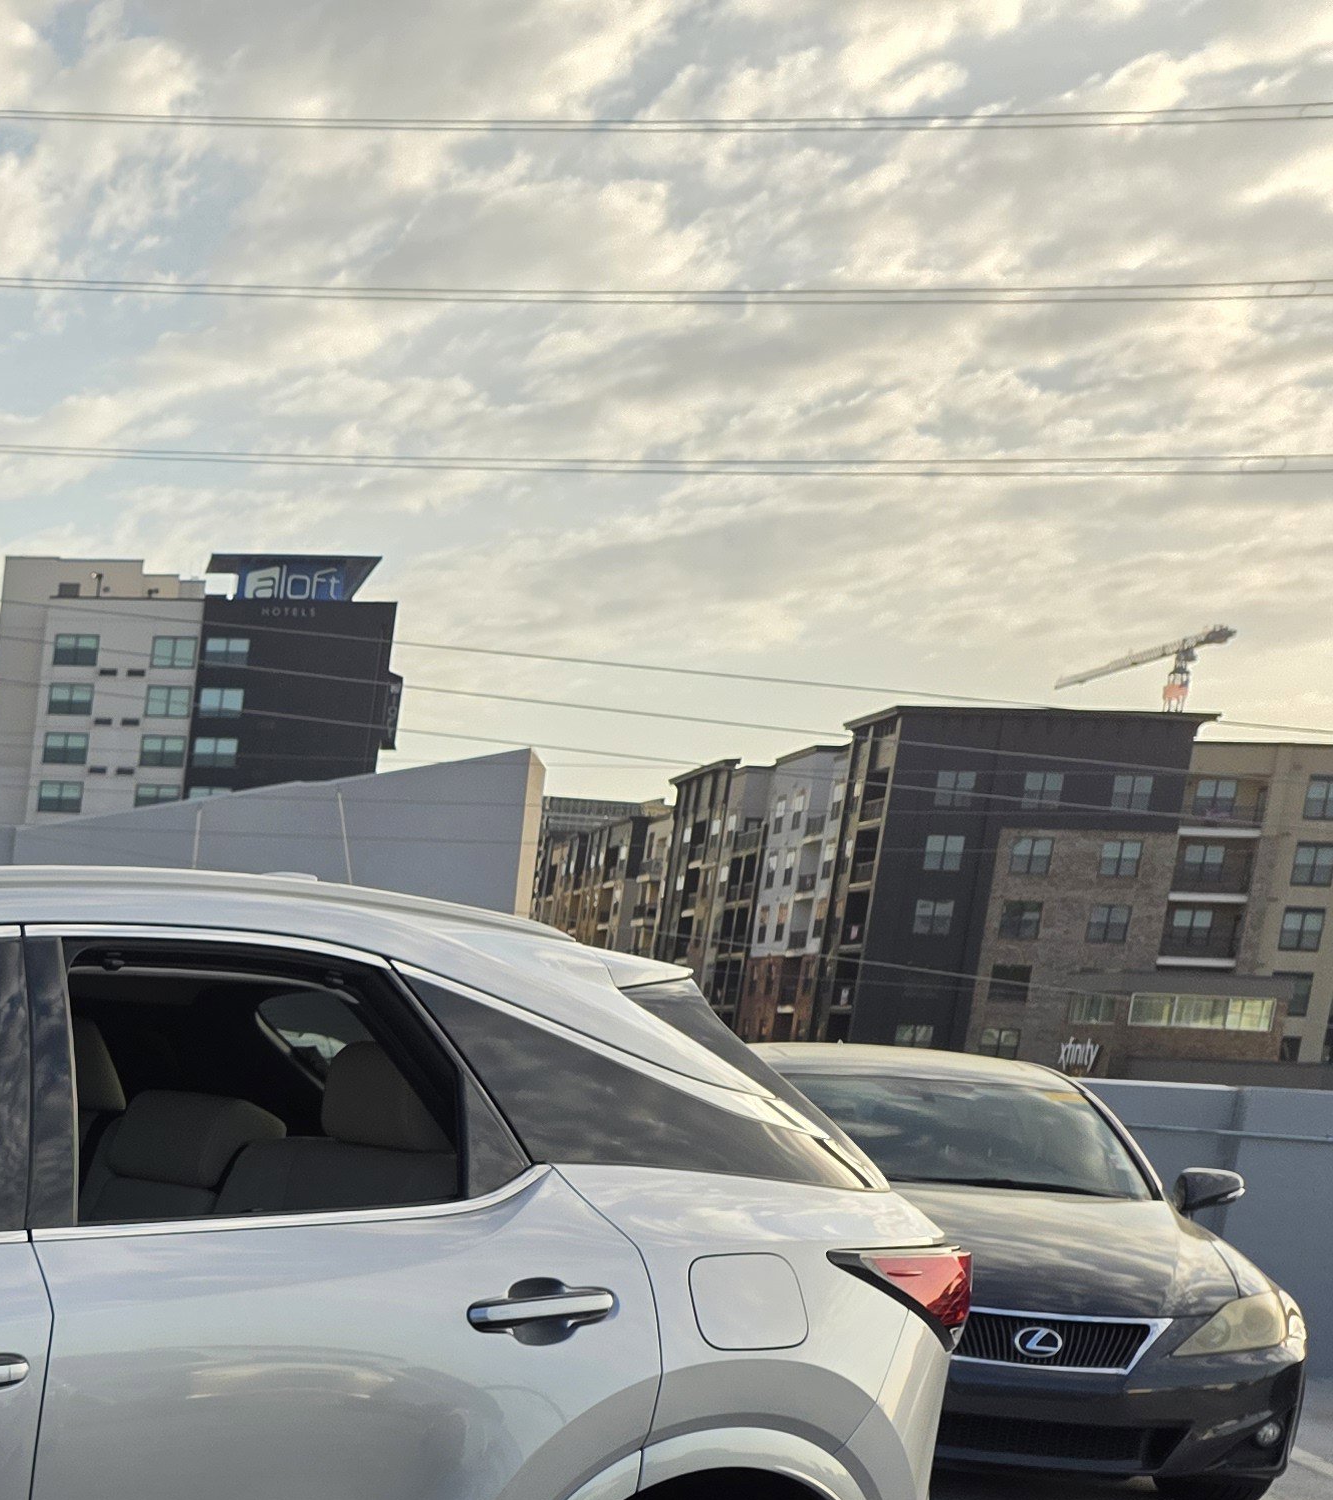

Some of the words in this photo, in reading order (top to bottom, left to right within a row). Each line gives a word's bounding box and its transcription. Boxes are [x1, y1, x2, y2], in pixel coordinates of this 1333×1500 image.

[244, 564, 340, 600] aloft
[261, 606, 316, 618] HOTELS
[1057, 1036, 1100, 1073] xfinity
